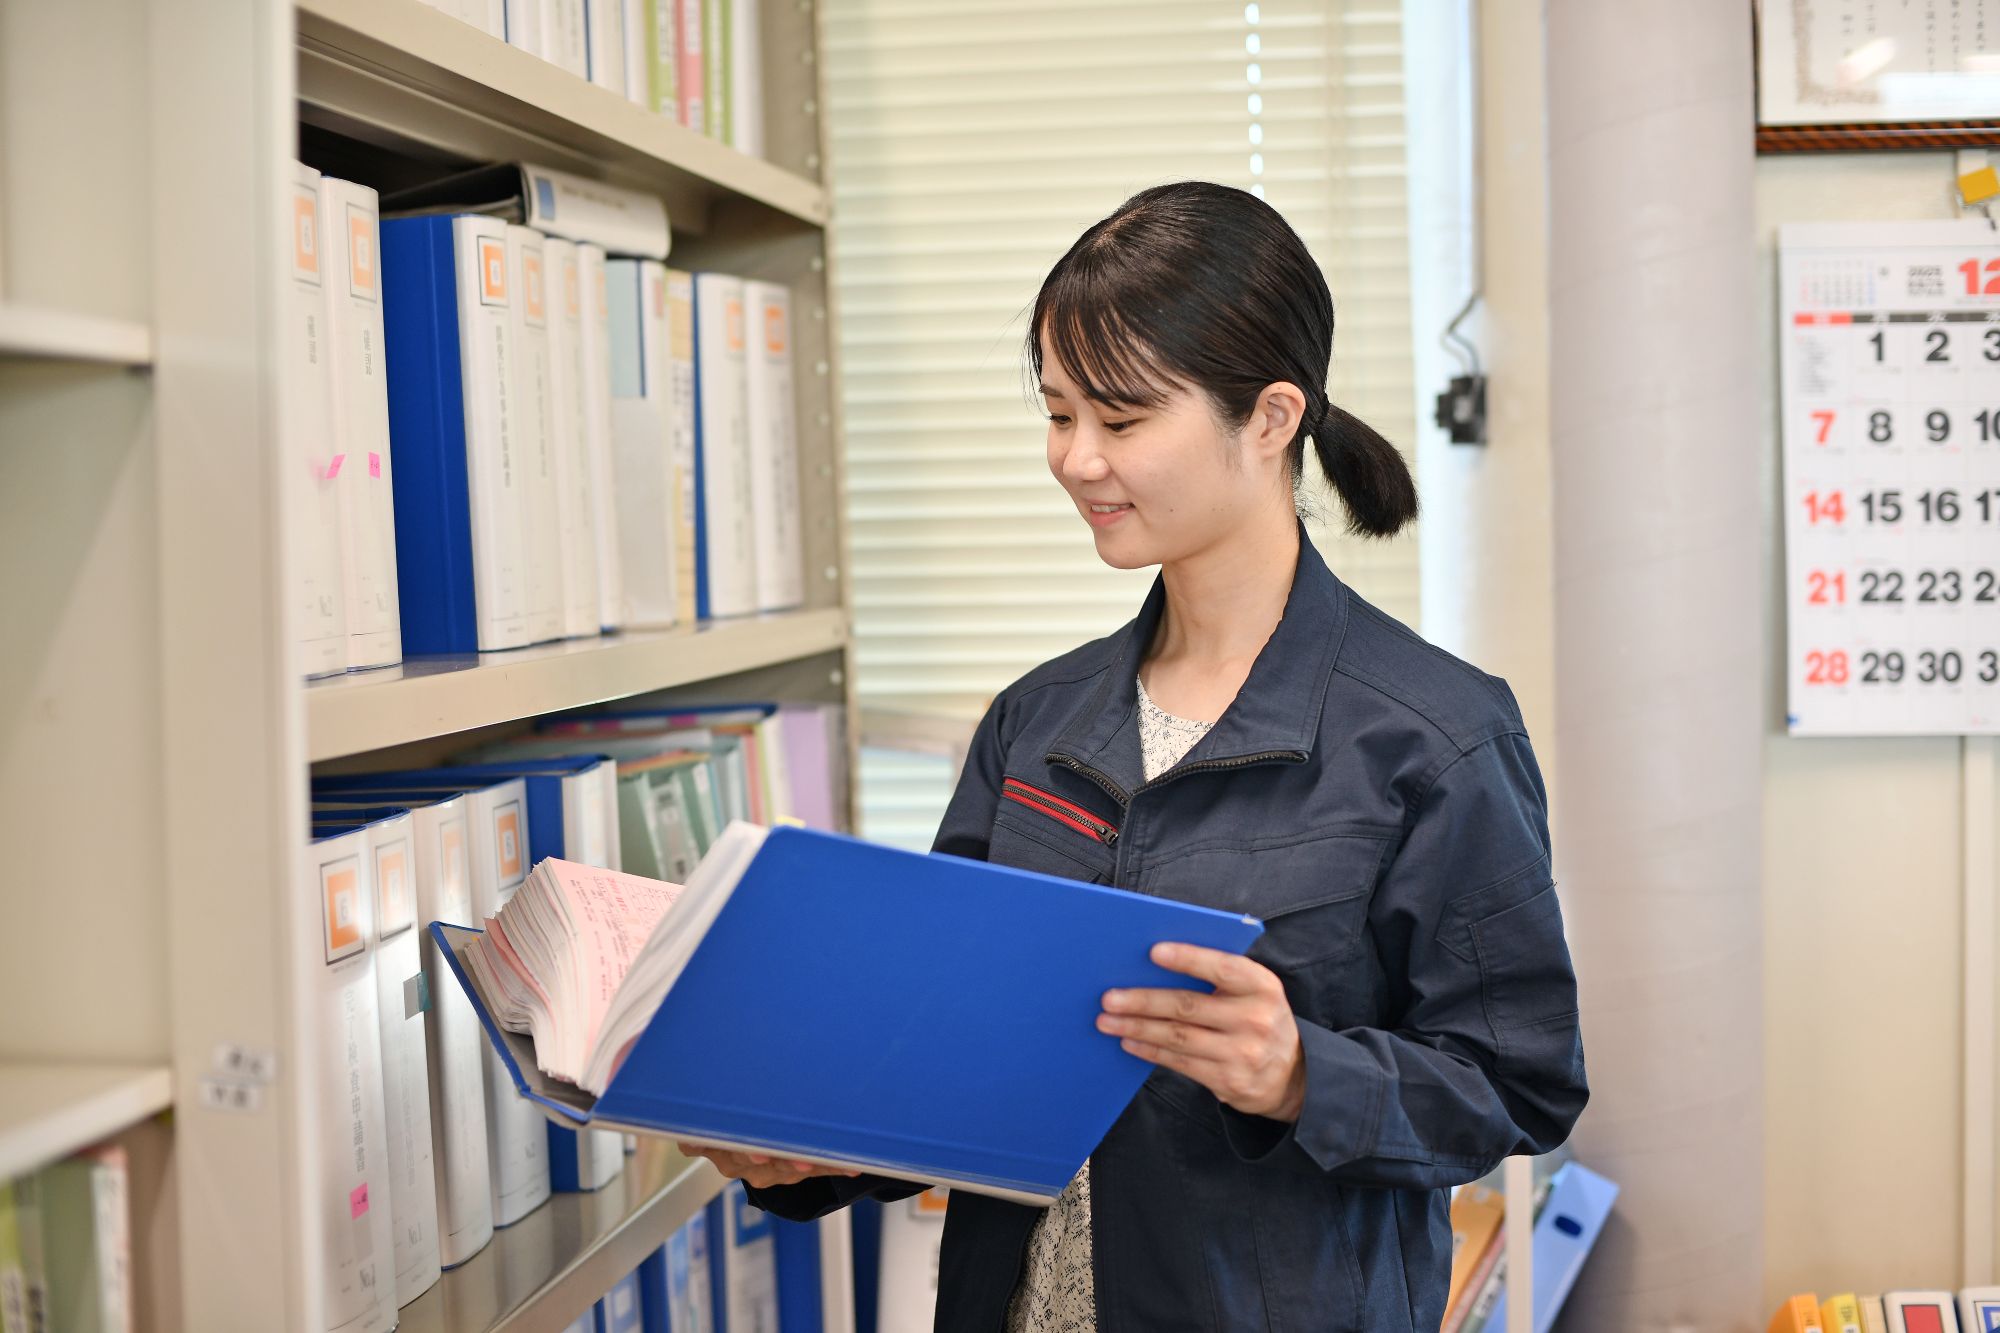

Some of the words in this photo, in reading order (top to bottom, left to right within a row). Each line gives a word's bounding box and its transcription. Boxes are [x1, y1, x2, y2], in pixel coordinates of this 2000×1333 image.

[1869, 331, 1884, 363] 1
[1925, 329, 1951, 363] 2
[1983, 328, 2000, 362] 3
[1811, 410, 1836, 445] 7
[1868, 410, 1893, 444] 8
[1925, 409, 1952, 443] 9
[1804, 491, 1847, 524] 14
[1860, 490, 1903, 524] 15
[1917, 489, 1961, 523] 16
[1975, 489, 2000, 522] 1
[1808, 571, 1846, 605] 21
[1860, 571, 1905, 603] 22
[1917, 570, 1963, 603] 23
[1974, 569, 2000, 603] 2
[1806, 650, 1850, 685] 28
[1861, 651, 1906, 684] 29
[1917, 650, 1963, 684] 30
